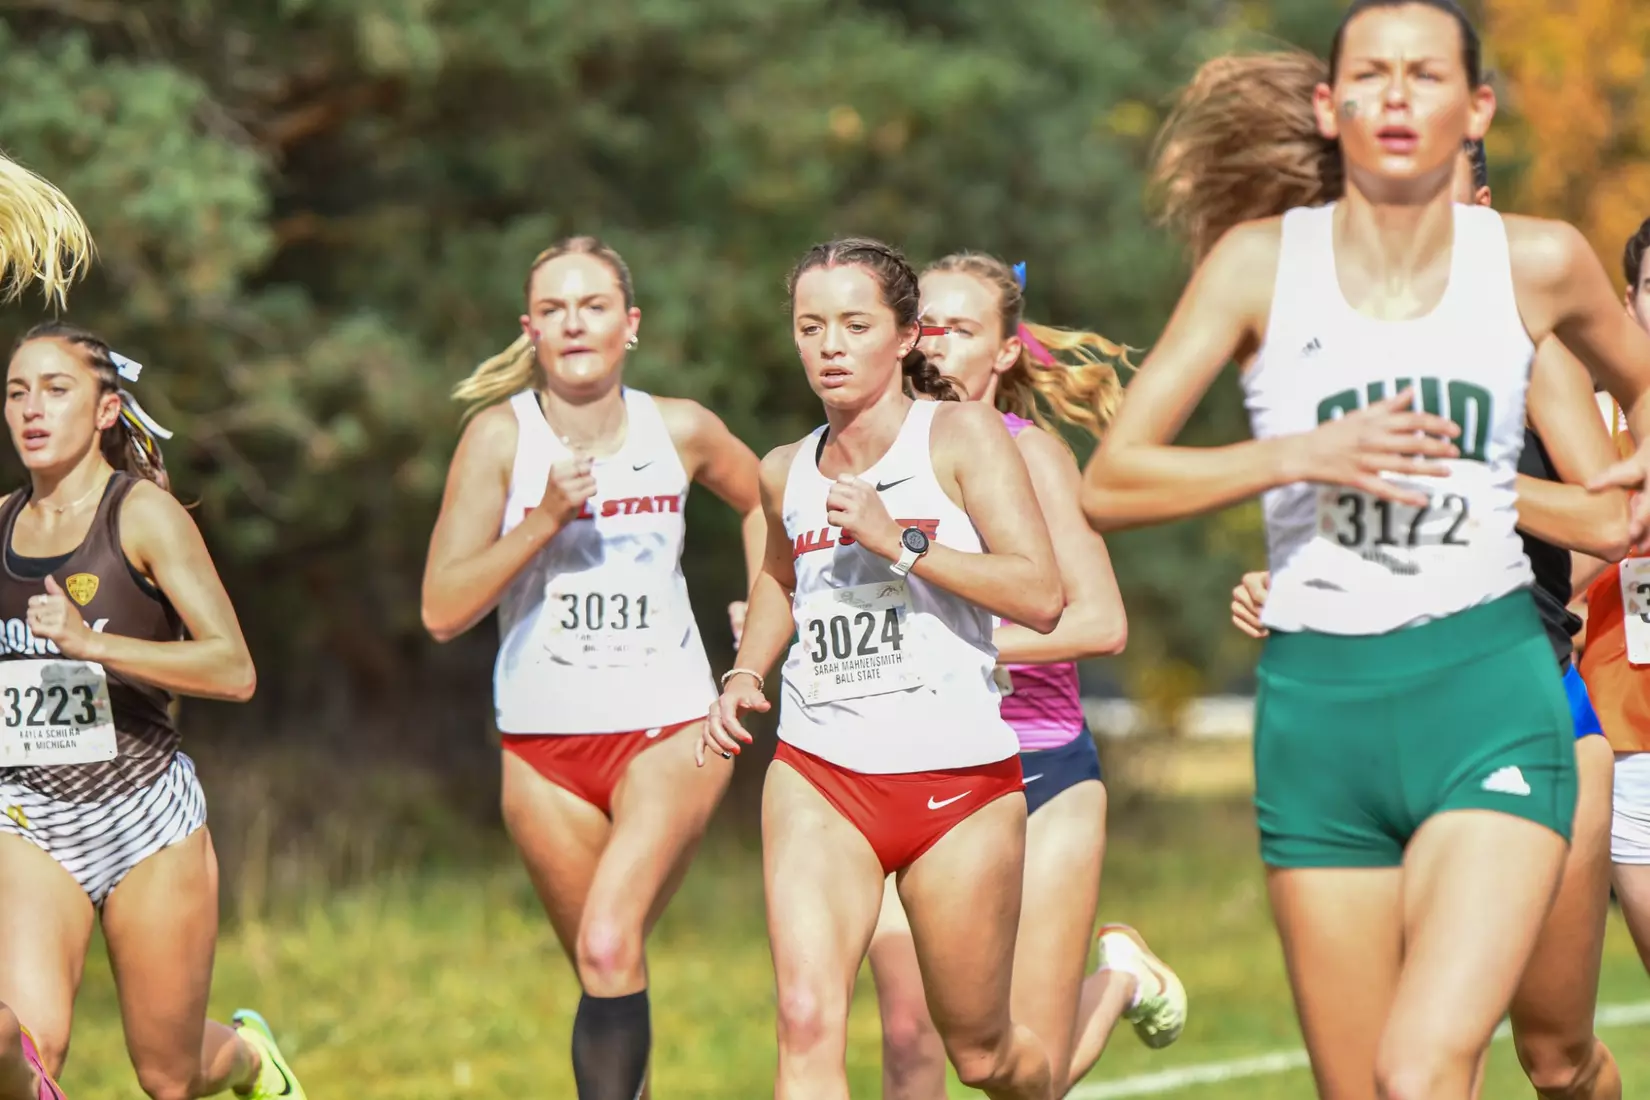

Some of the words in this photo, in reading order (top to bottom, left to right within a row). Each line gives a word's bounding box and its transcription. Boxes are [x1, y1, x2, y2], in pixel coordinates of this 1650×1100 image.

[1336, 493, 1470, 547] 3172
[792, 527, 835, 559] ALL
[561, 592, 650, 630] 3031
[809, 607, 904, 664] 3024
[814, 662, 839, 676] SARAH
[842, 653, 902, 671] MAHNENSMITH
[835, 673, 855, 684] BALL
[857, 668, 881, 681] STATE
[4, 685, 97, 728] 3223
[36, 740, 77, 750] MICHIGAN
